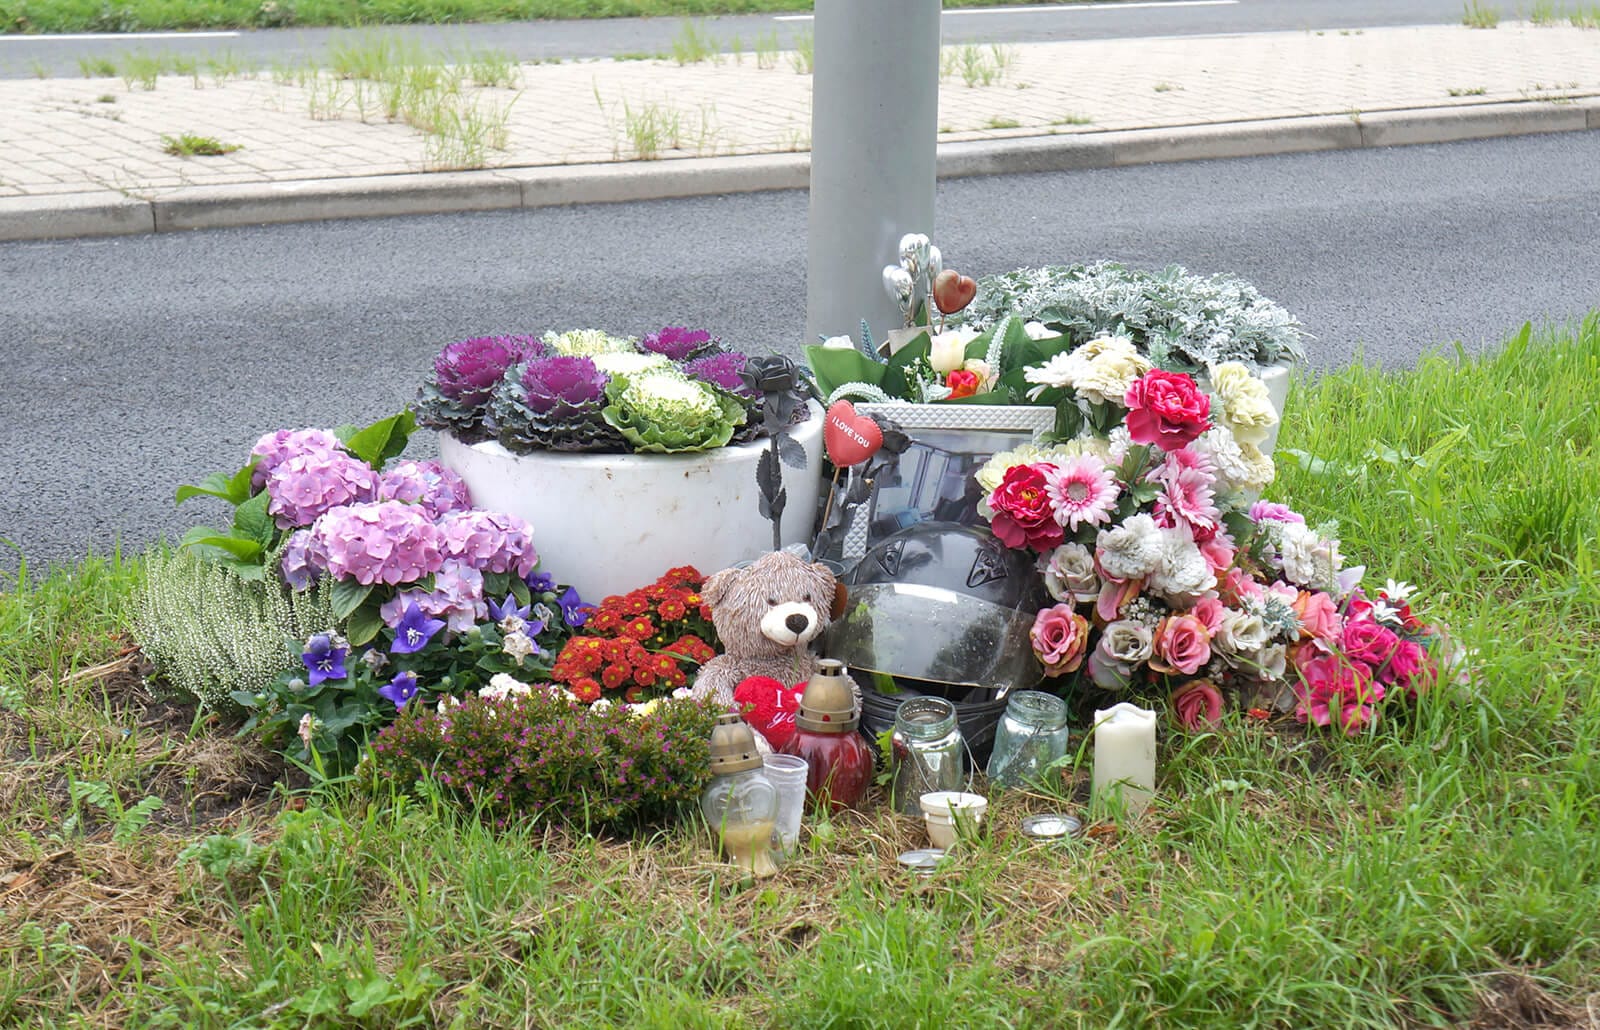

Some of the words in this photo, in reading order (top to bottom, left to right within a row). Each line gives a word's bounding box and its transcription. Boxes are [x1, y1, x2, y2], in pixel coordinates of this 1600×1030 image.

[835, 418, 854, 437] LOVE
[853, 432, 870, 448] YOU
[776, 689, 783, 708] I
[766, 711, 796, 729] yo
